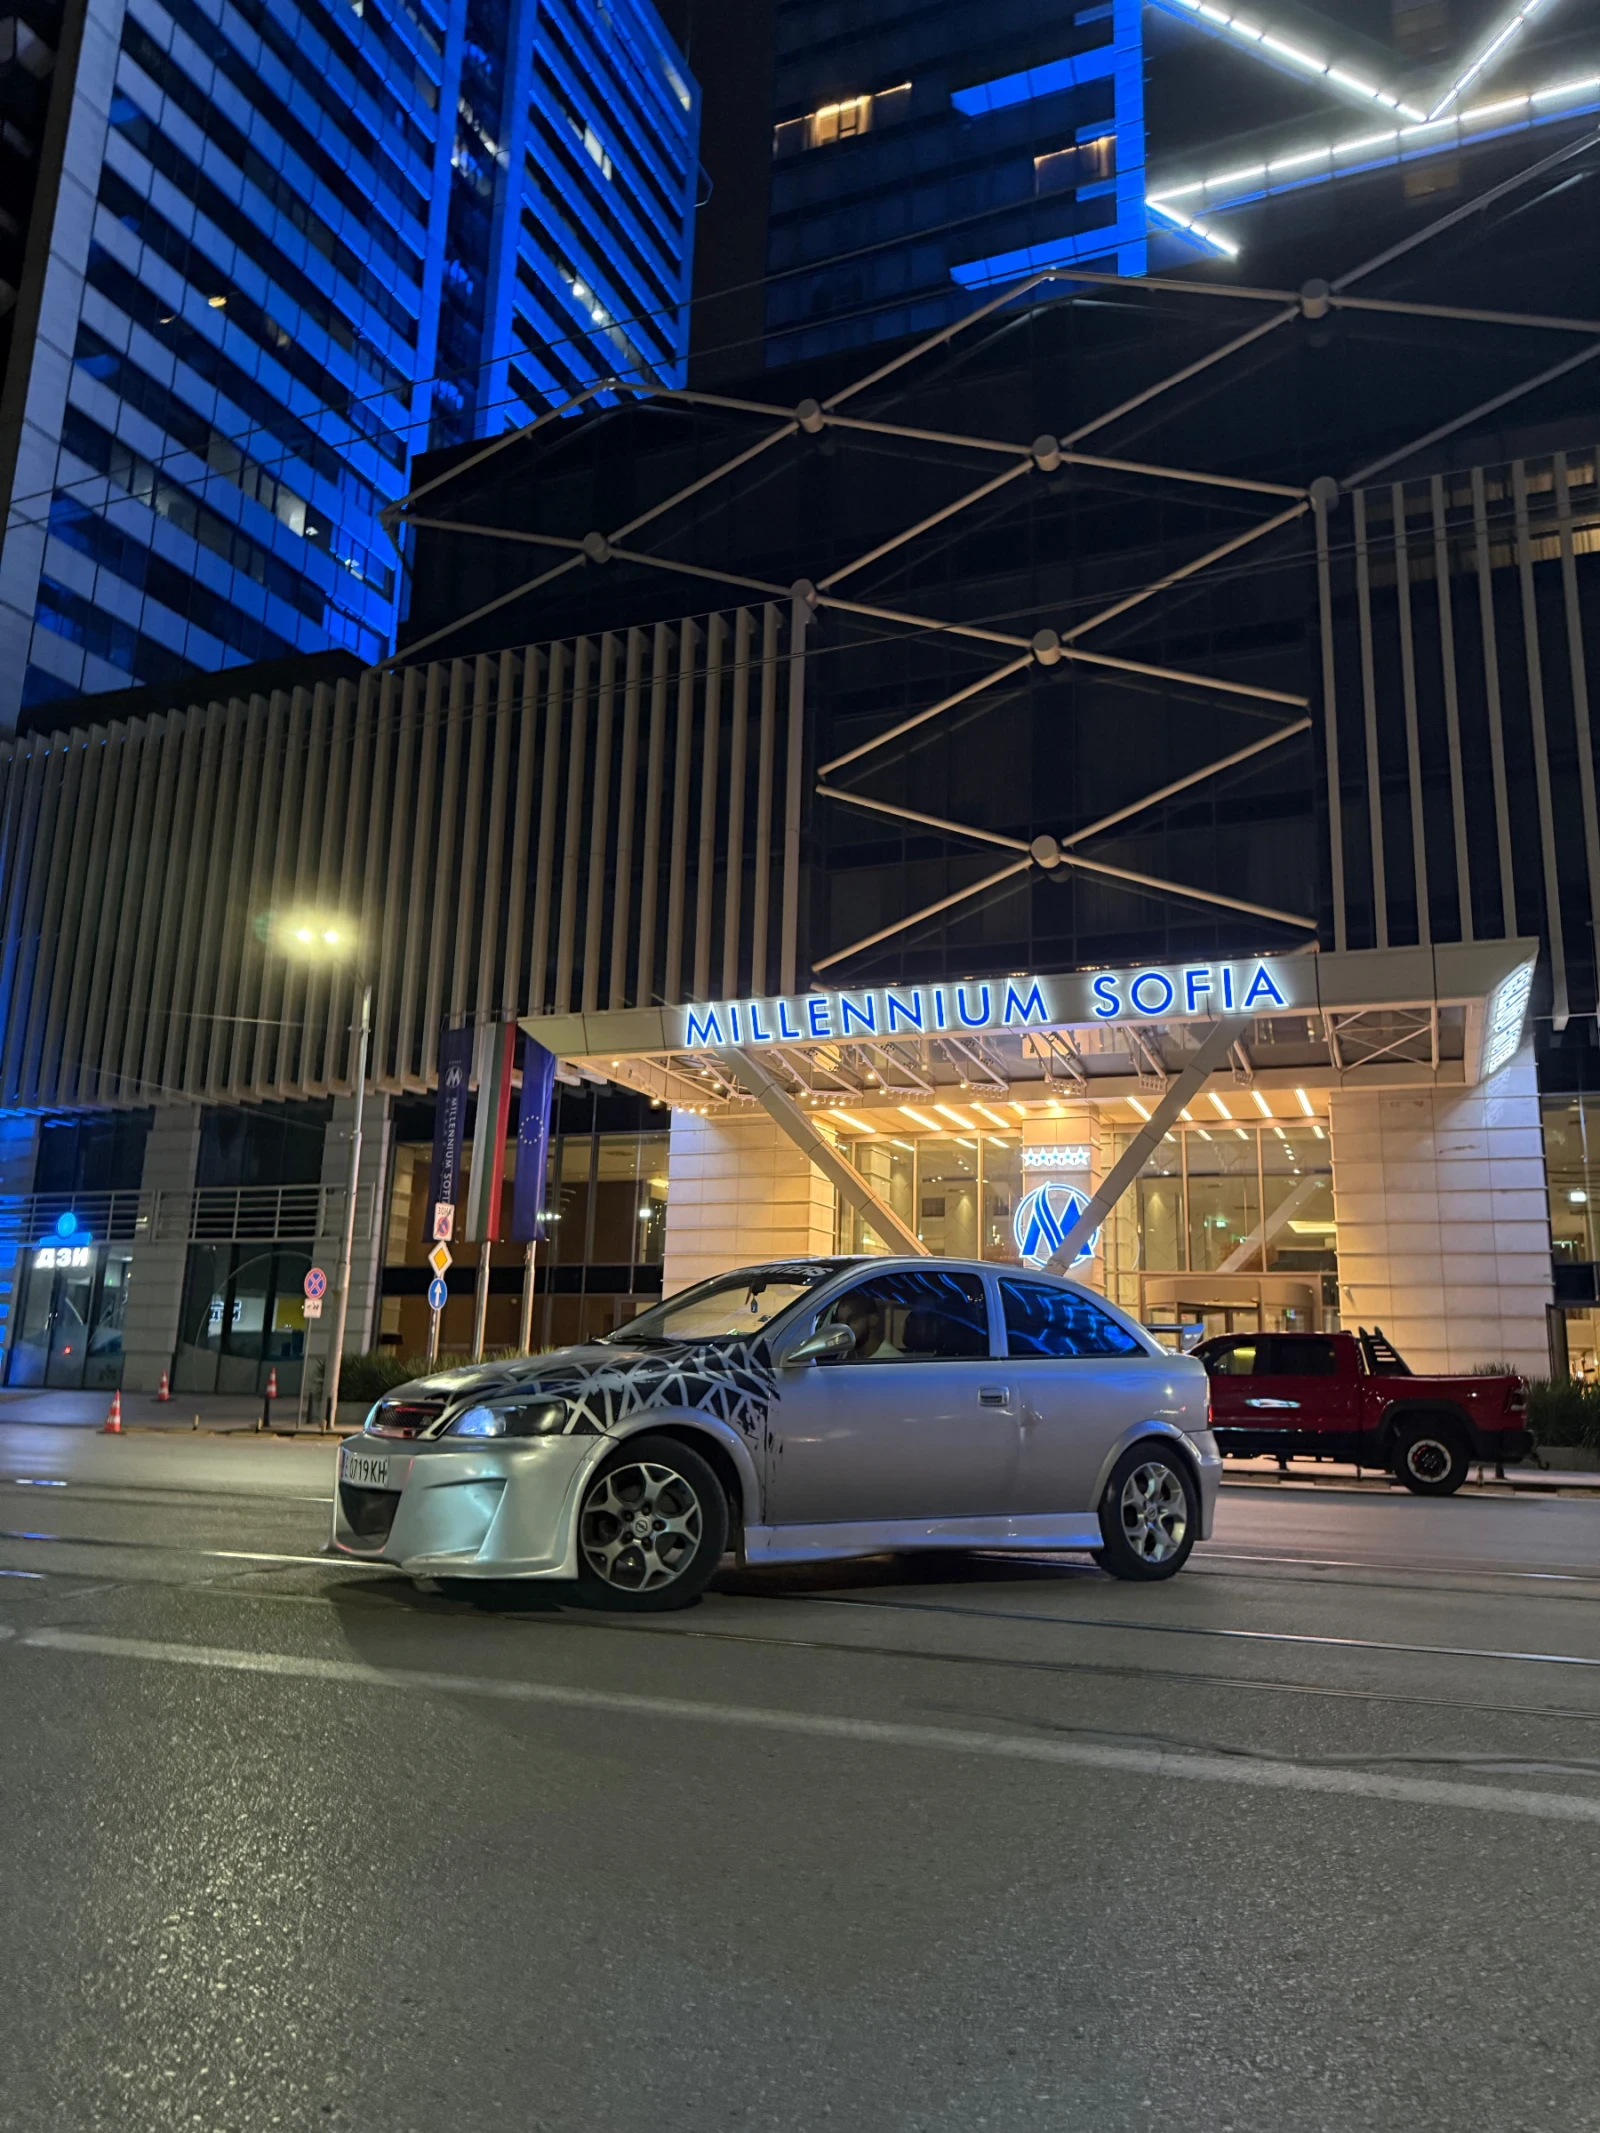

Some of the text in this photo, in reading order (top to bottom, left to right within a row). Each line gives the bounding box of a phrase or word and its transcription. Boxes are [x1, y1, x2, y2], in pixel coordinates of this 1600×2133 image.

[685, 959, 1288, 1048] MILLENNIUM SOFIA
[444, 1097, 457, 1169] MILLENNIUM
[441, 1173, 452, 1203] SOFI
[34, 1247, 89, 1269] ДЗИ
